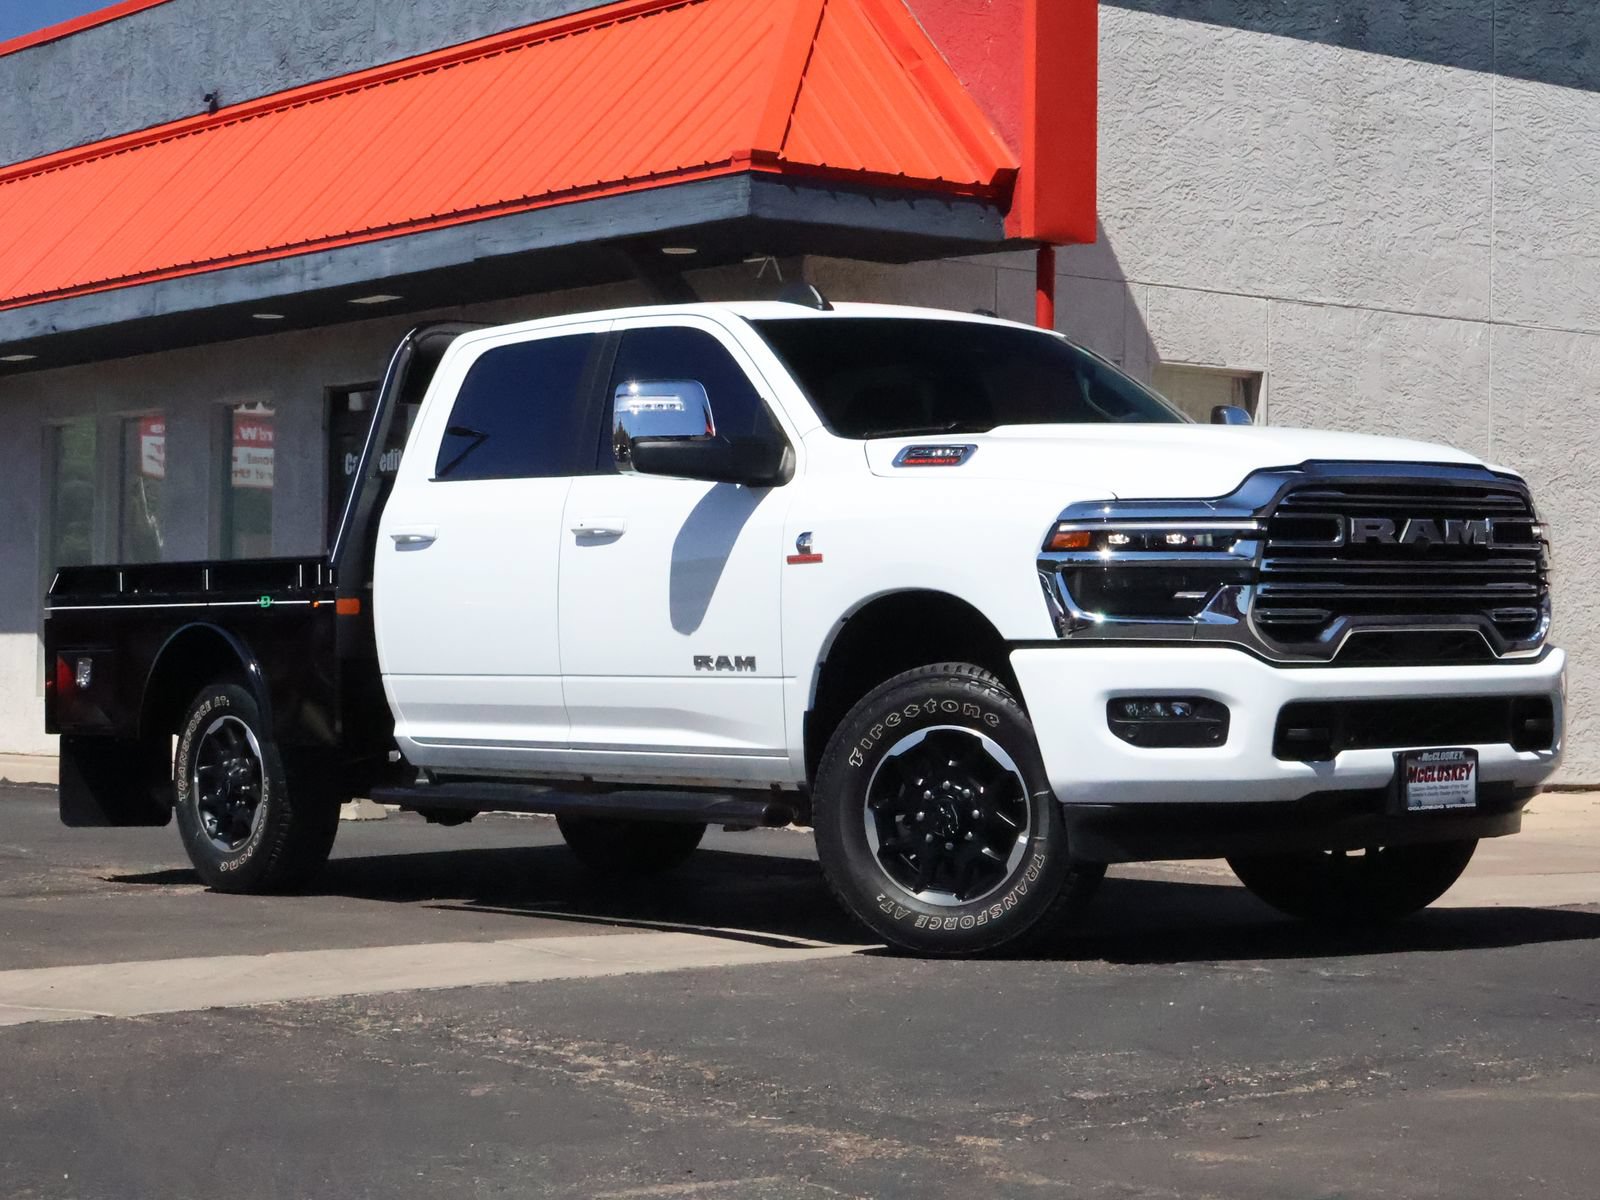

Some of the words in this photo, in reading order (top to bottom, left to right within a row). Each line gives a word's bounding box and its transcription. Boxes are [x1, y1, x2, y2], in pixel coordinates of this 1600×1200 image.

[1350, 517, 1488, 544] RAM
[693, 655, 757, 672] RAM
[178, 699, 212, 802] TRANSFORCE
[848, 698, 1001, 768] Firestone
[1408, 763, 1474, 783] McCLOSKEY
[914, 854, 1046, 930] TRANSFORCE
